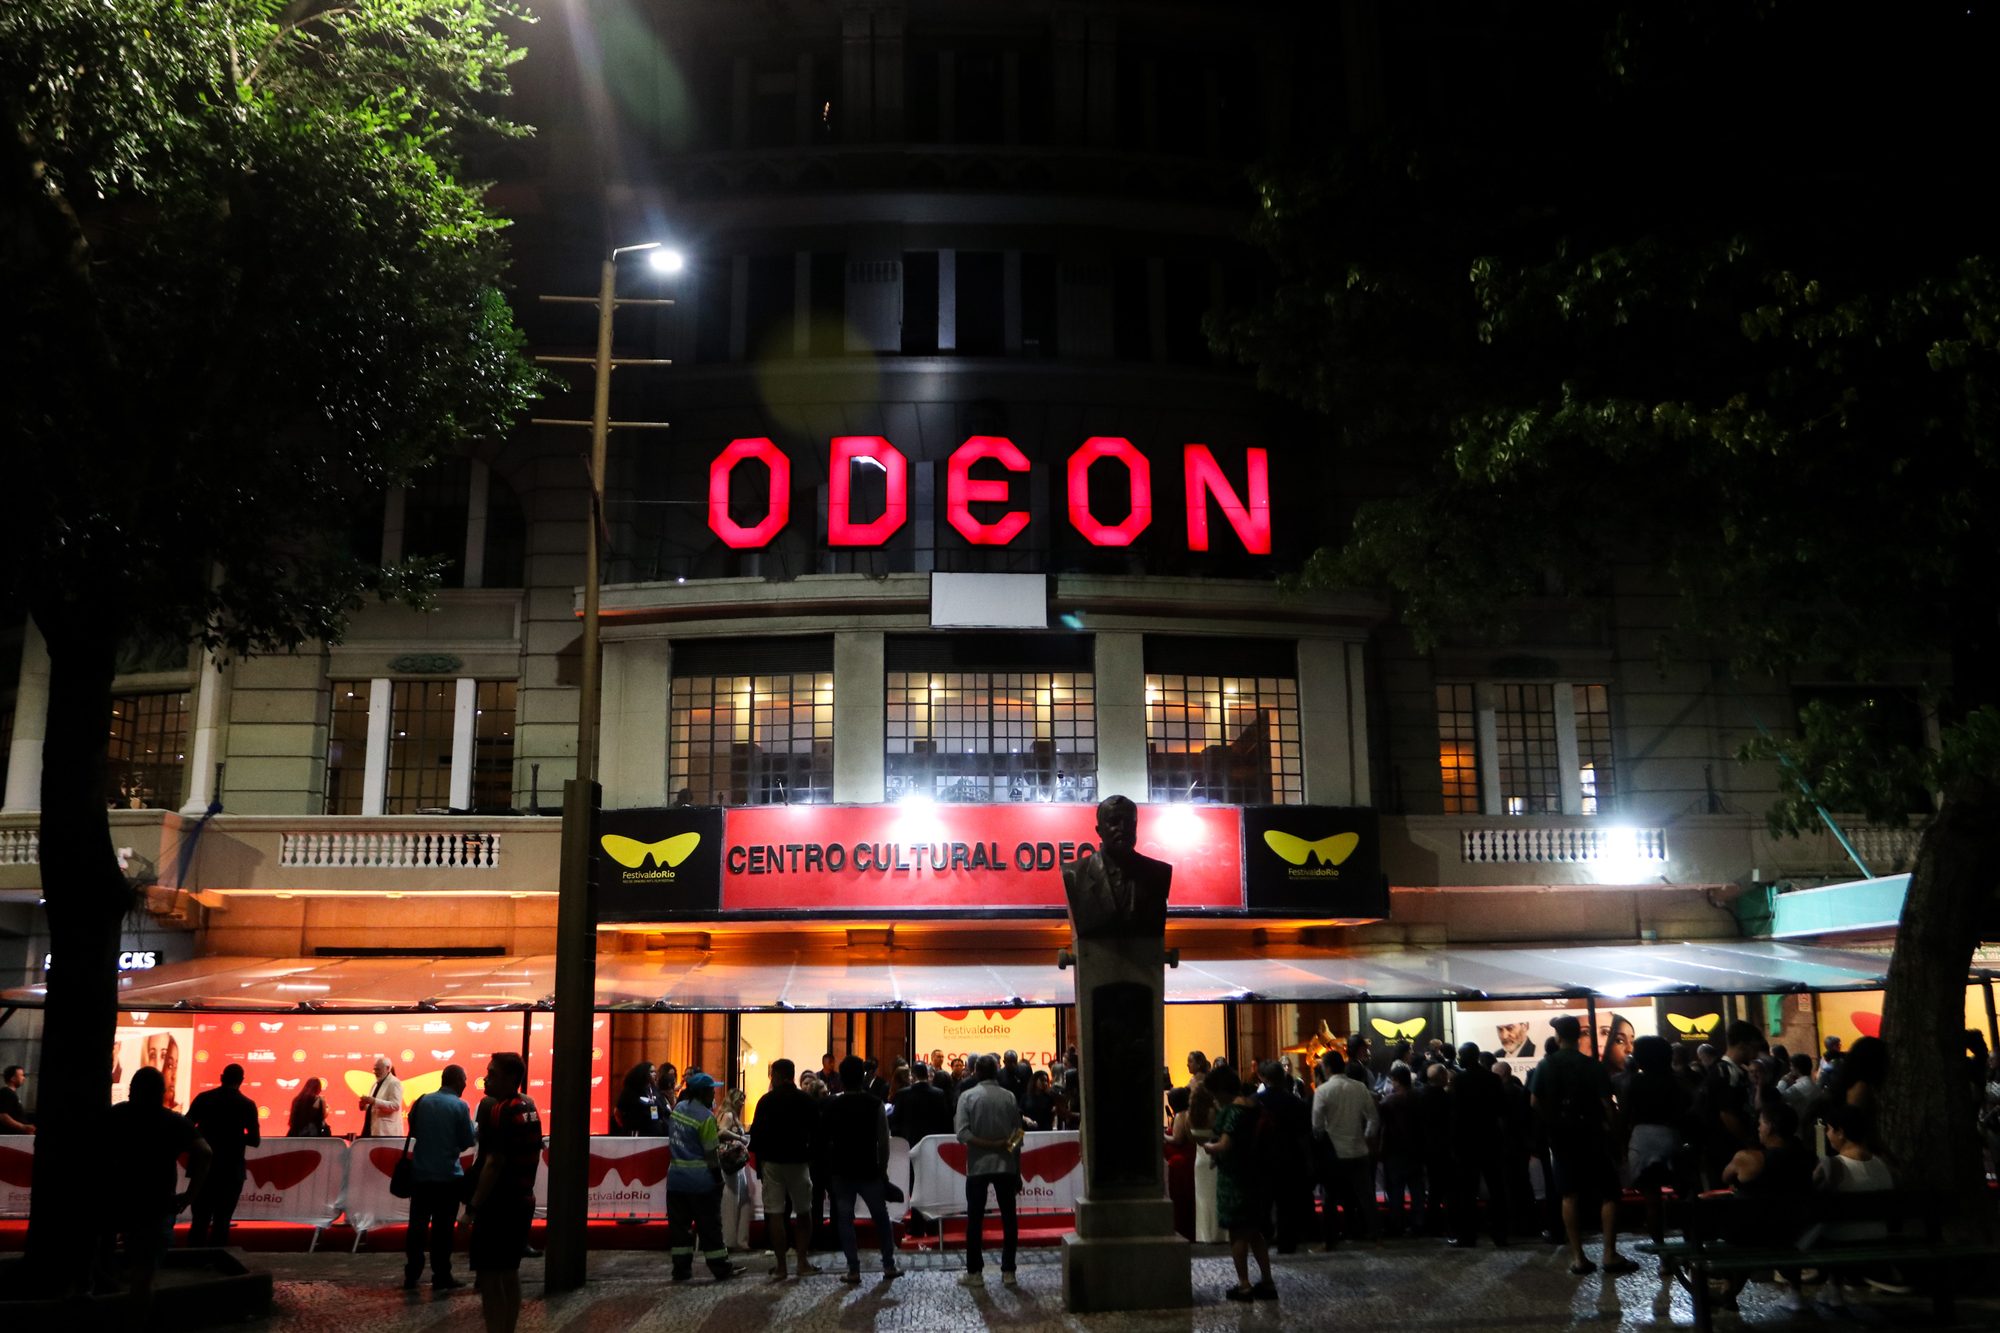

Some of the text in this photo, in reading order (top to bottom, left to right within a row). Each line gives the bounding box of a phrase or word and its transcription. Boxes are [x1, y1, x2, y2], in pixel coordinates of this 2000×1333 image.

[707, 434, 1273, 556] ODEON
[727, 841, 1103, 875] CENTRO CULTURAL ODEO
[622, 870, 675, 879] FestivaldoRio
[943, 1024, 1011, 1035] FestivaldoRio
